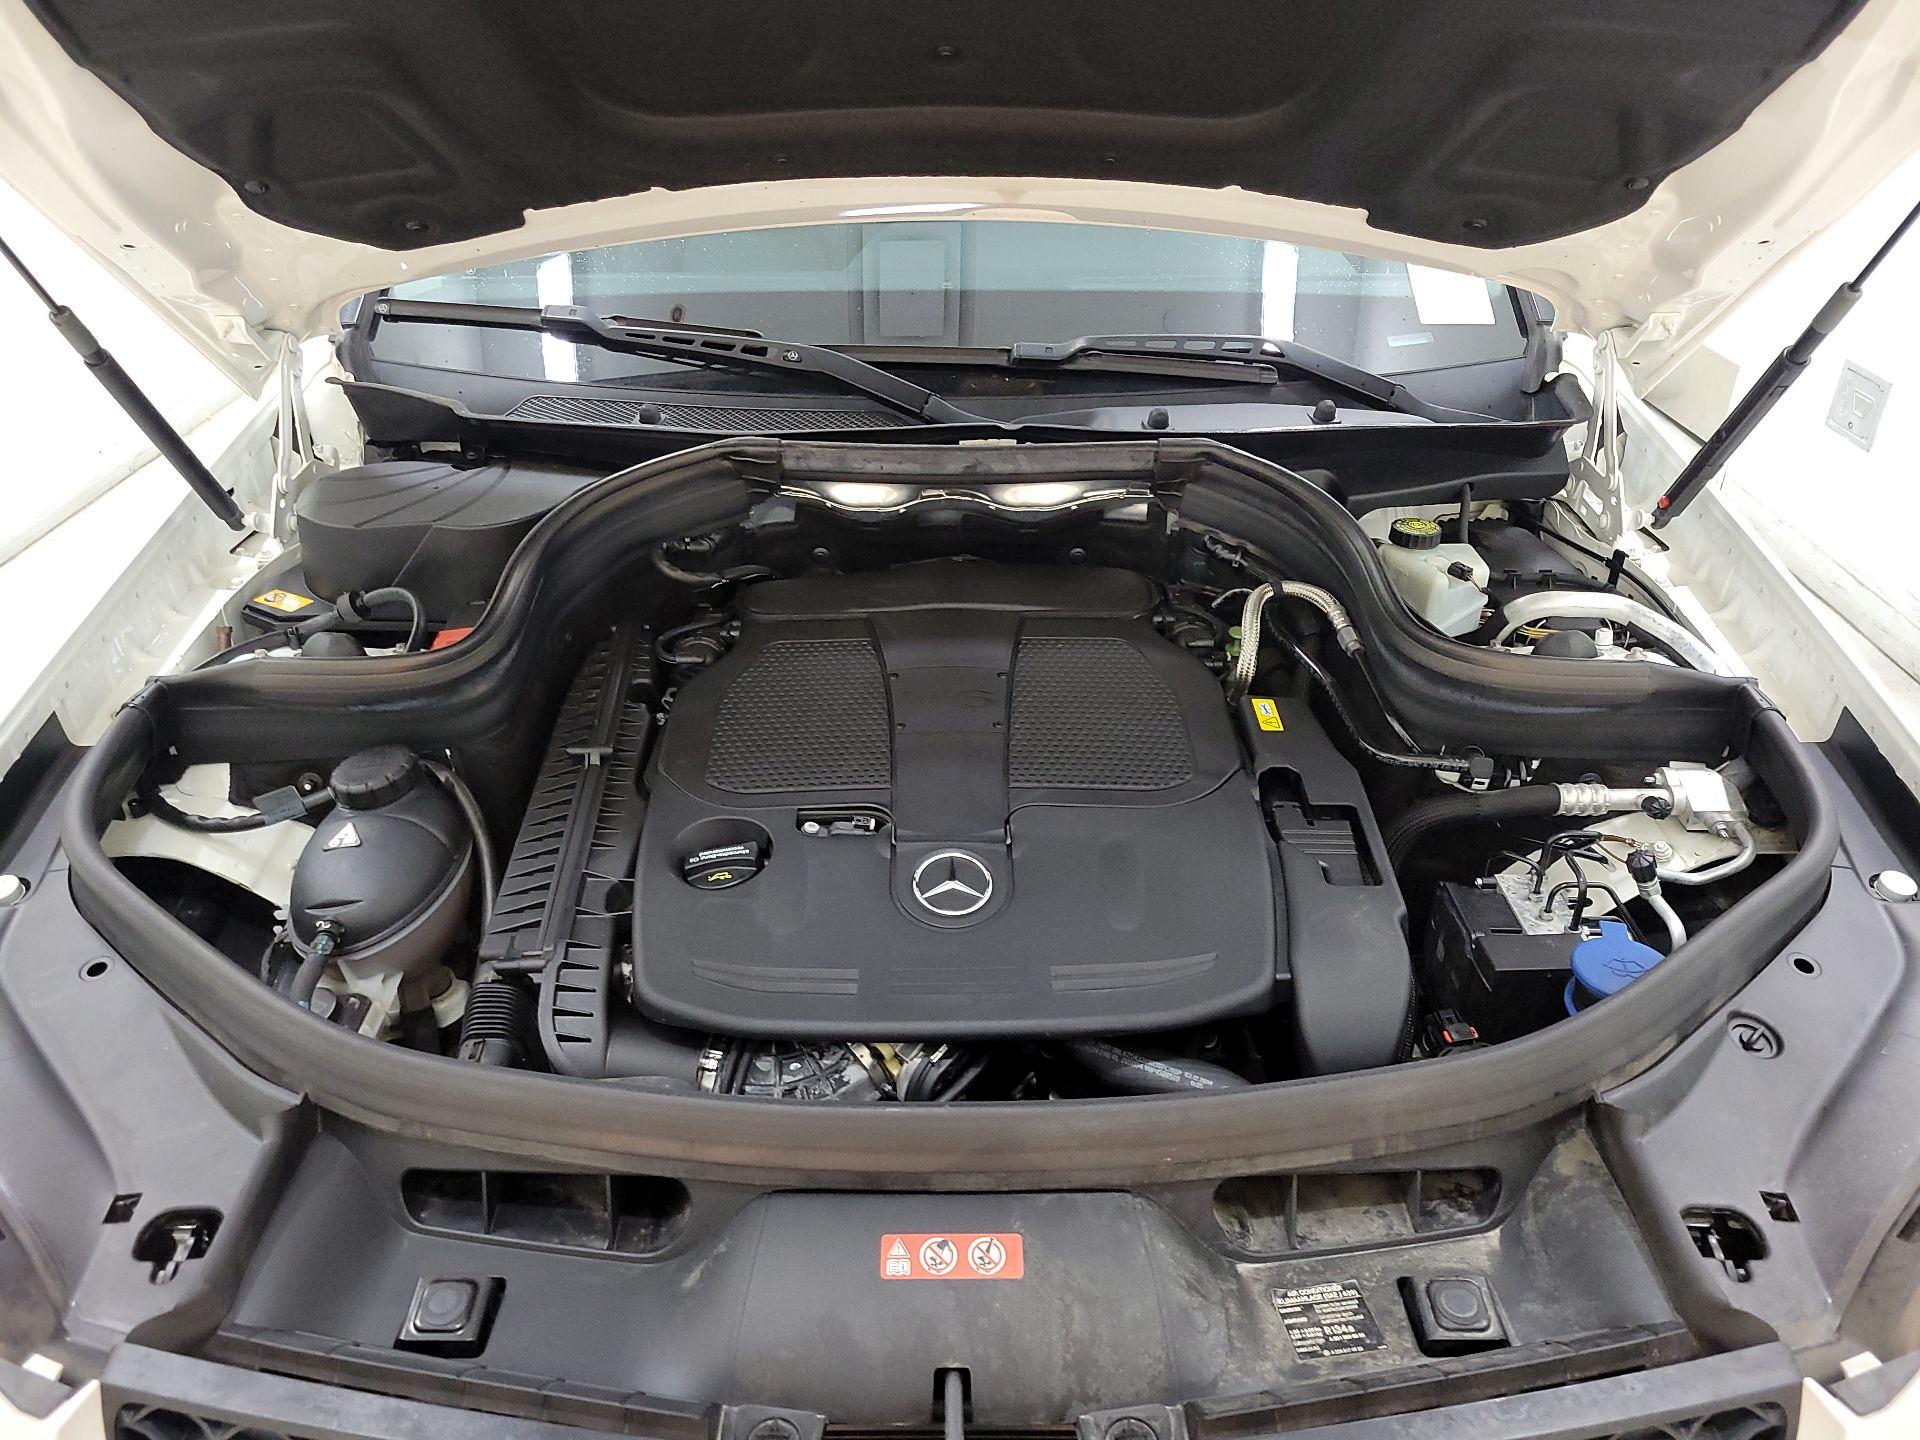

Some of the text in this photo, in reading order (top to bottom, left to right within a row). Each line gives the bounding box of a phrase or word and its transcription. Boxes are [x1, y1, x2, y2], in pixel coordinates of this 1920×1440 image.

[1287, 1283, 1343, 1297] AIR CONDITIONER
[1323, 1324, 1356, 1335] R134a
